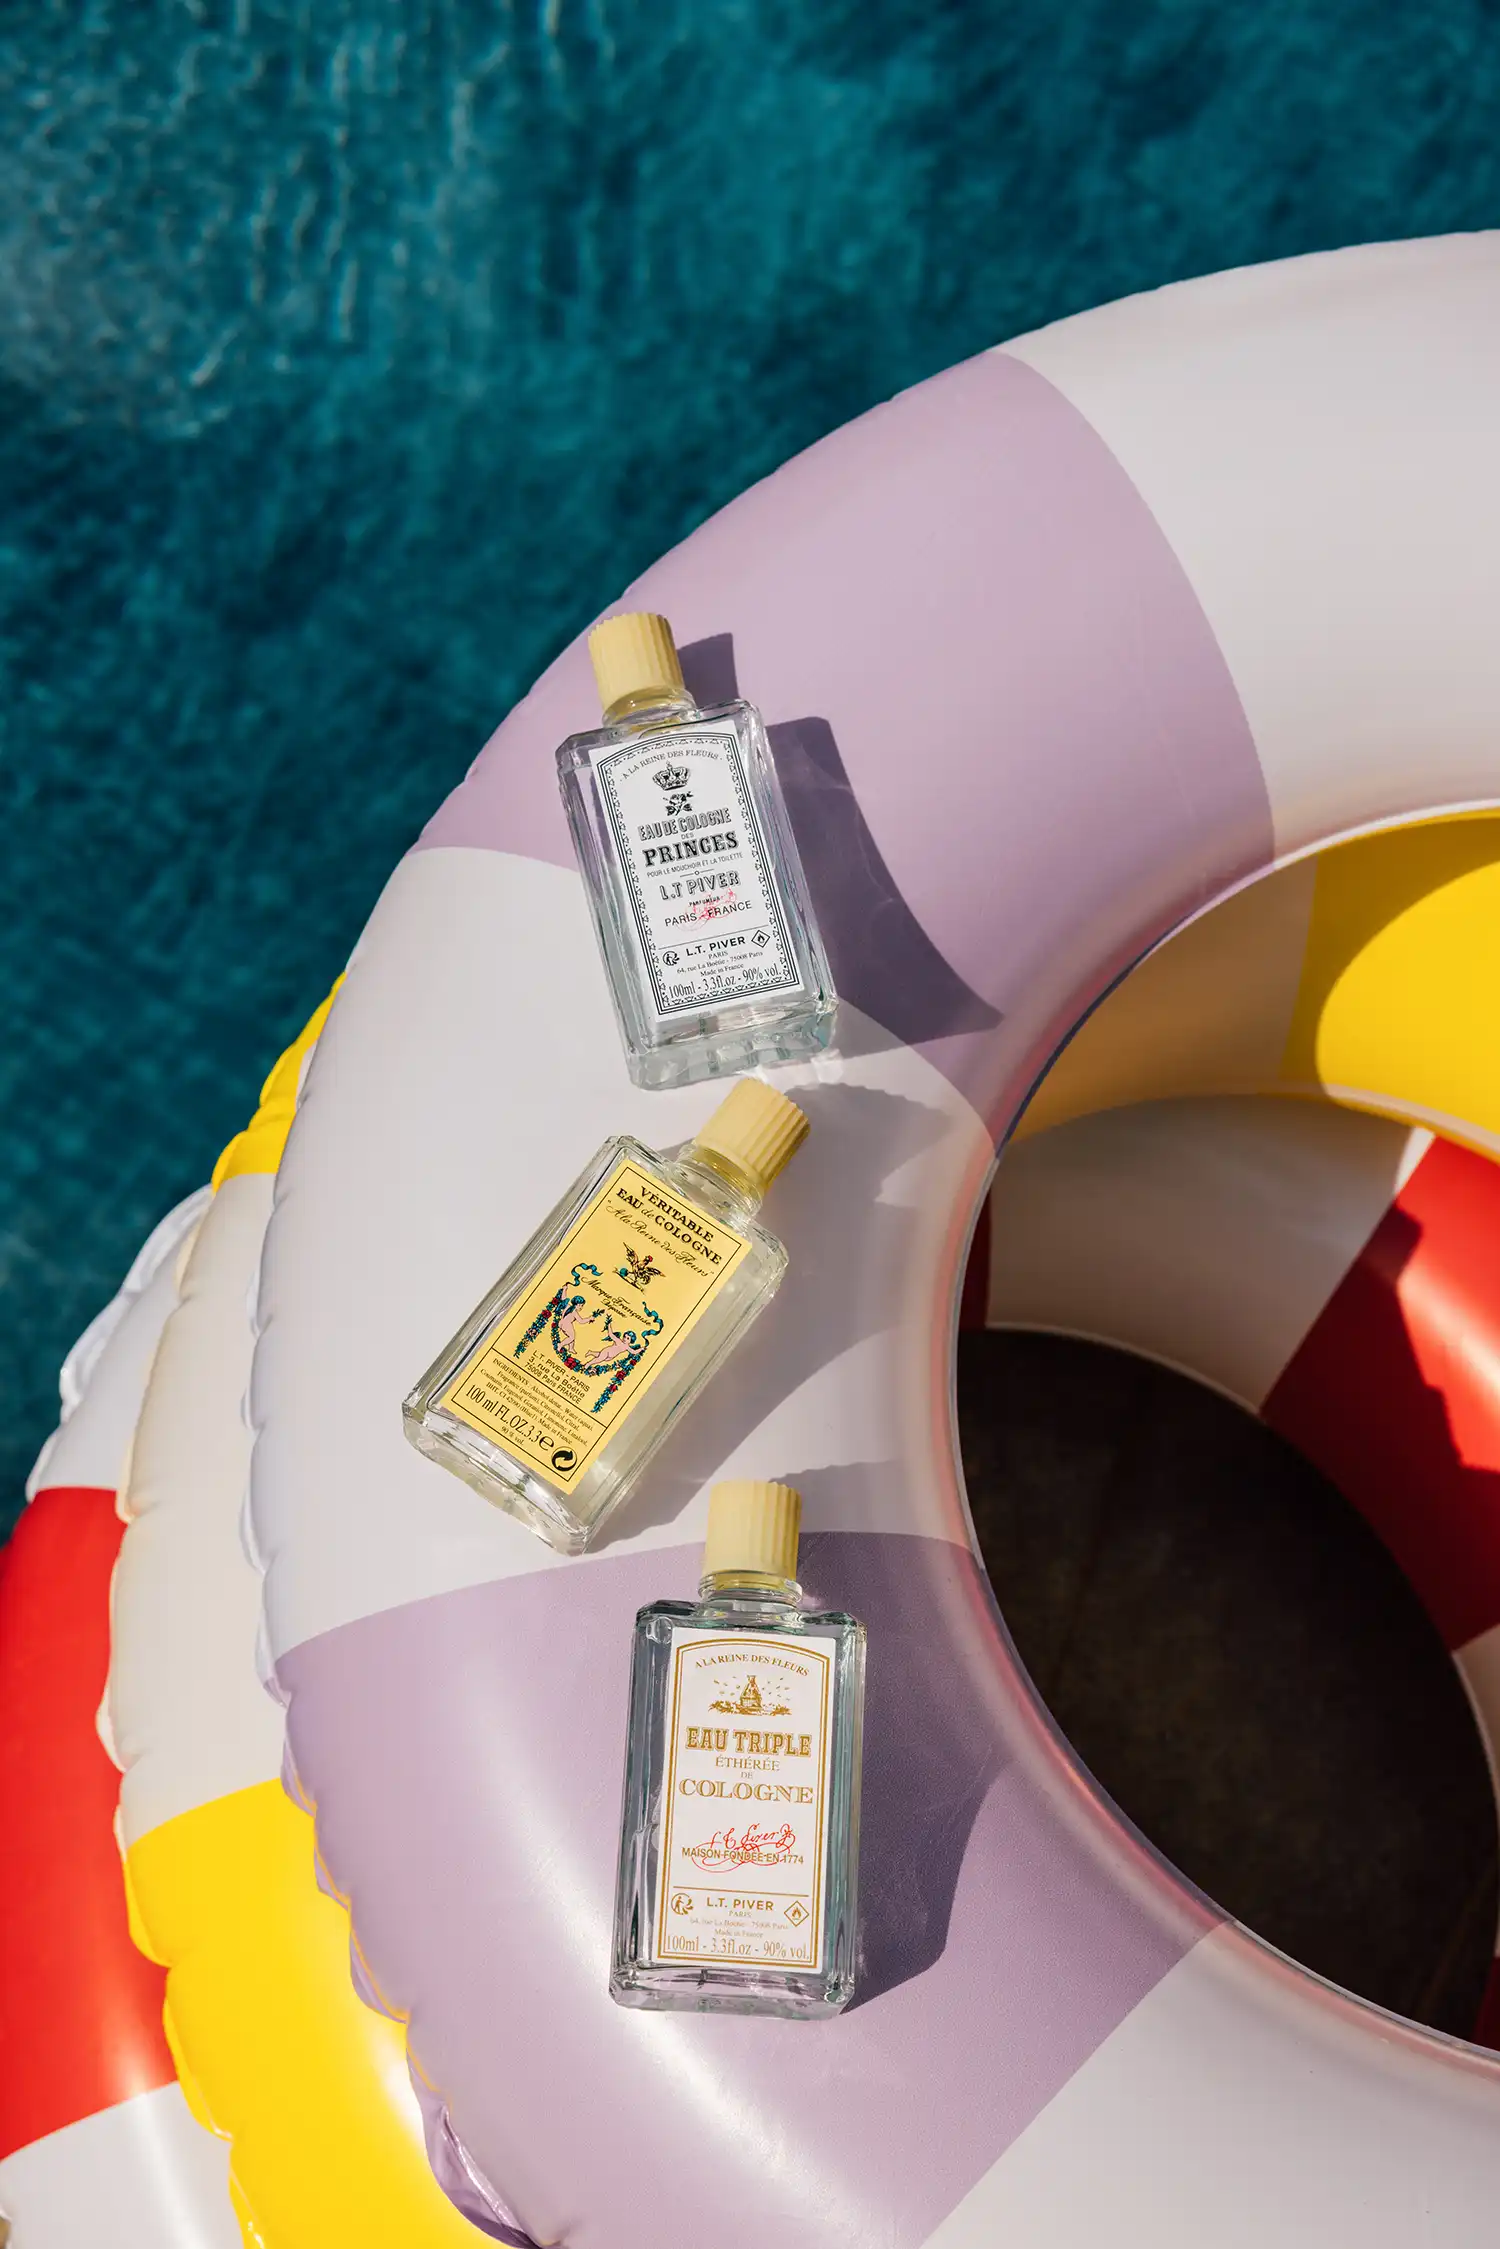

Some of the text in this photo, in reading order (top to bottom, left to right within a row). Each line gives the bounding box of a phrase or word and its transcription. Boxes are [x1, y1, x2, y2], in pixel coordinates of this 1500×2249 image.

[628, 765, 640, 774] LA
[640, 753, 665, 767] REINE
[667, 750, 684, 758] DES
[685, 750, 719, 760] FLEURS
[637, 807, 732, 842] EAU DE COLOGNE
[680, 832, 695, 840] DES
[642, 830, 740, 867] PRINCES
[647, 869, 663, 878] POUR
[663, 867, 670, 875] LE
[671, 861, 701, 873] MOUCHOIR
[718, 852, 744, 863] TOILETTE
[686, 870, 741, 895] PIVER
[665, 912, 698, 927] PARIS
[707, 900, 752, 917] FRANCE
[685, 936, 746, 957] L.T. PIVER
[708, 951, 729, 960] PARIS
[730, 953, 748, 961] 75008
[669, 981, 696, 999] 100ml
[702, 974, 737, 992] 3.3fl.oz
[742, 966, 763, 982] 90%
[764, 962, 781, 977] vol.
[700, 969, 717, 977] Made
[724, 963, 744, 972] France
[617, 1188, 721, 1264] EAU de COLOGNE
[642, 1186, 713, 1242] VÉRITABLE
[630, 1220, 661, 1245] Reine
[660, 1241, 676, 1256] des
[581, 1277, 651, 1325] Marque Française
[497, 1371, 519, 1389] Fragrance
[528, 1355, 536, 1366] 3,
[538, 1364, 550, 1373] rue
[551, 1372, 560, 1381] La
[533, 1350, 545, 1361] L.T.
[546, 1359, 566, 1375] PIVER
[570, 1376, 590, 1392] PARIS
[493, 1358, 528, 1385] INGREDIENTS
[531, 1386, 550, 1400] Alcohol
[565, 1408, 578, 1420] Water
[525, 1362, 581, 1404] 75008 Paris FRANCE
[466, 1385, 485, 1403] 100
[482, 1399, 498, 1412] ml
[538, 1419, 551, 1430] Made
[557, 1431, 572, 1444] France
[702, 1658, 717, 1667] LA
[718, 1654, 749, 1664] REINE
[751, 1654, 770, 1664] DES
[771, 1657, 810, 1677] FLEURS
[685, 1725, 813, 1758] EAU TRIPLE
[715, 1754, 780, 1772] ÉTHÉRÉE
[740, 1771, 754, 1779] DE
[679, 1778, 813, 1804] COLOGNE
[681, 1847, 720, 1859] MAISON
[767, 1852, 780, 1863] EN
[782, 1853, 804, 1865] 1774
[706, 1897, 774, 1911] L.T. PIVER
[728, 1910, 752, 1918] PARIS
[667, 1935, 699, 1952] 100ml
[710, 1938, 751, 1955] 3.3fl.oz
[763, 1940, 786, 1958] 90%
[790, 1942, 810, 1959] vol.
